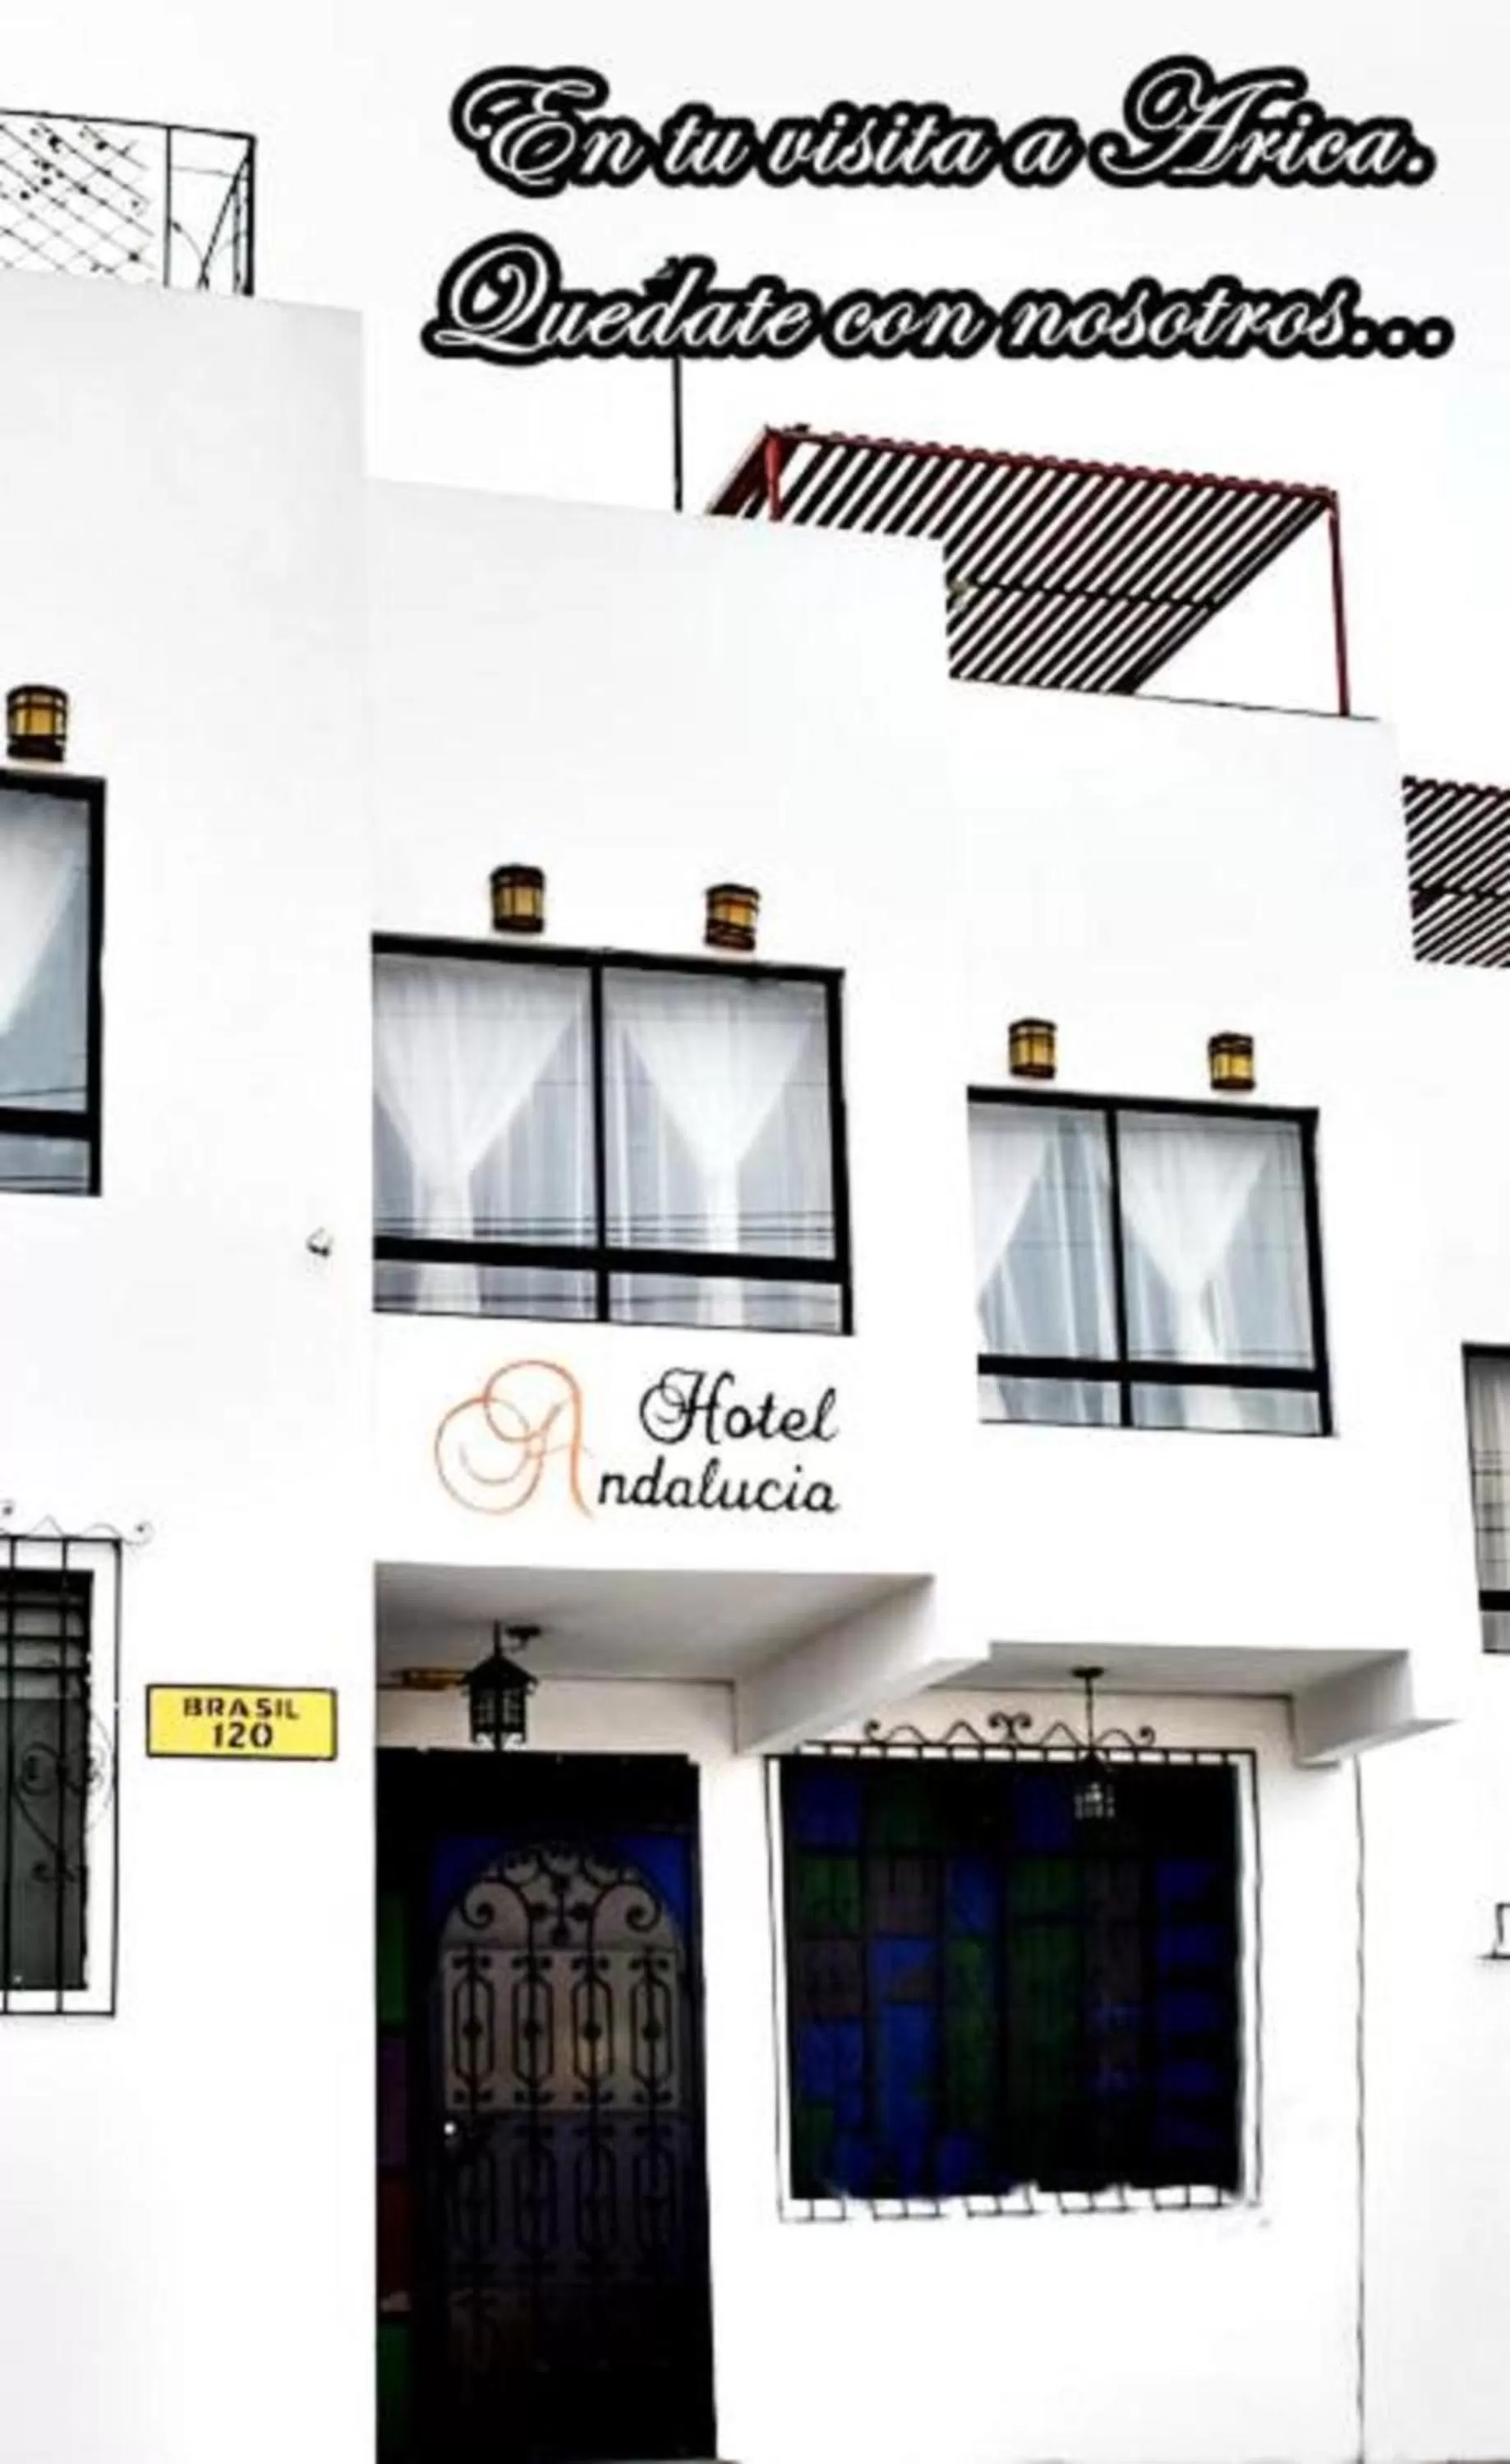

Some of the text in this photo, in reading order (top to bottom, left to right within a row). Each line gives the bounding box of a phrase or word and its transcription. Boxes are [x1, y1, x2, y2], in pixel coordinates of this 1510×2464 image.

[639, 1366, 839, 1446] Hotel
[182, 1696, 300, 1720] BRASIL
[212, 1722, 274, 1749] 120
